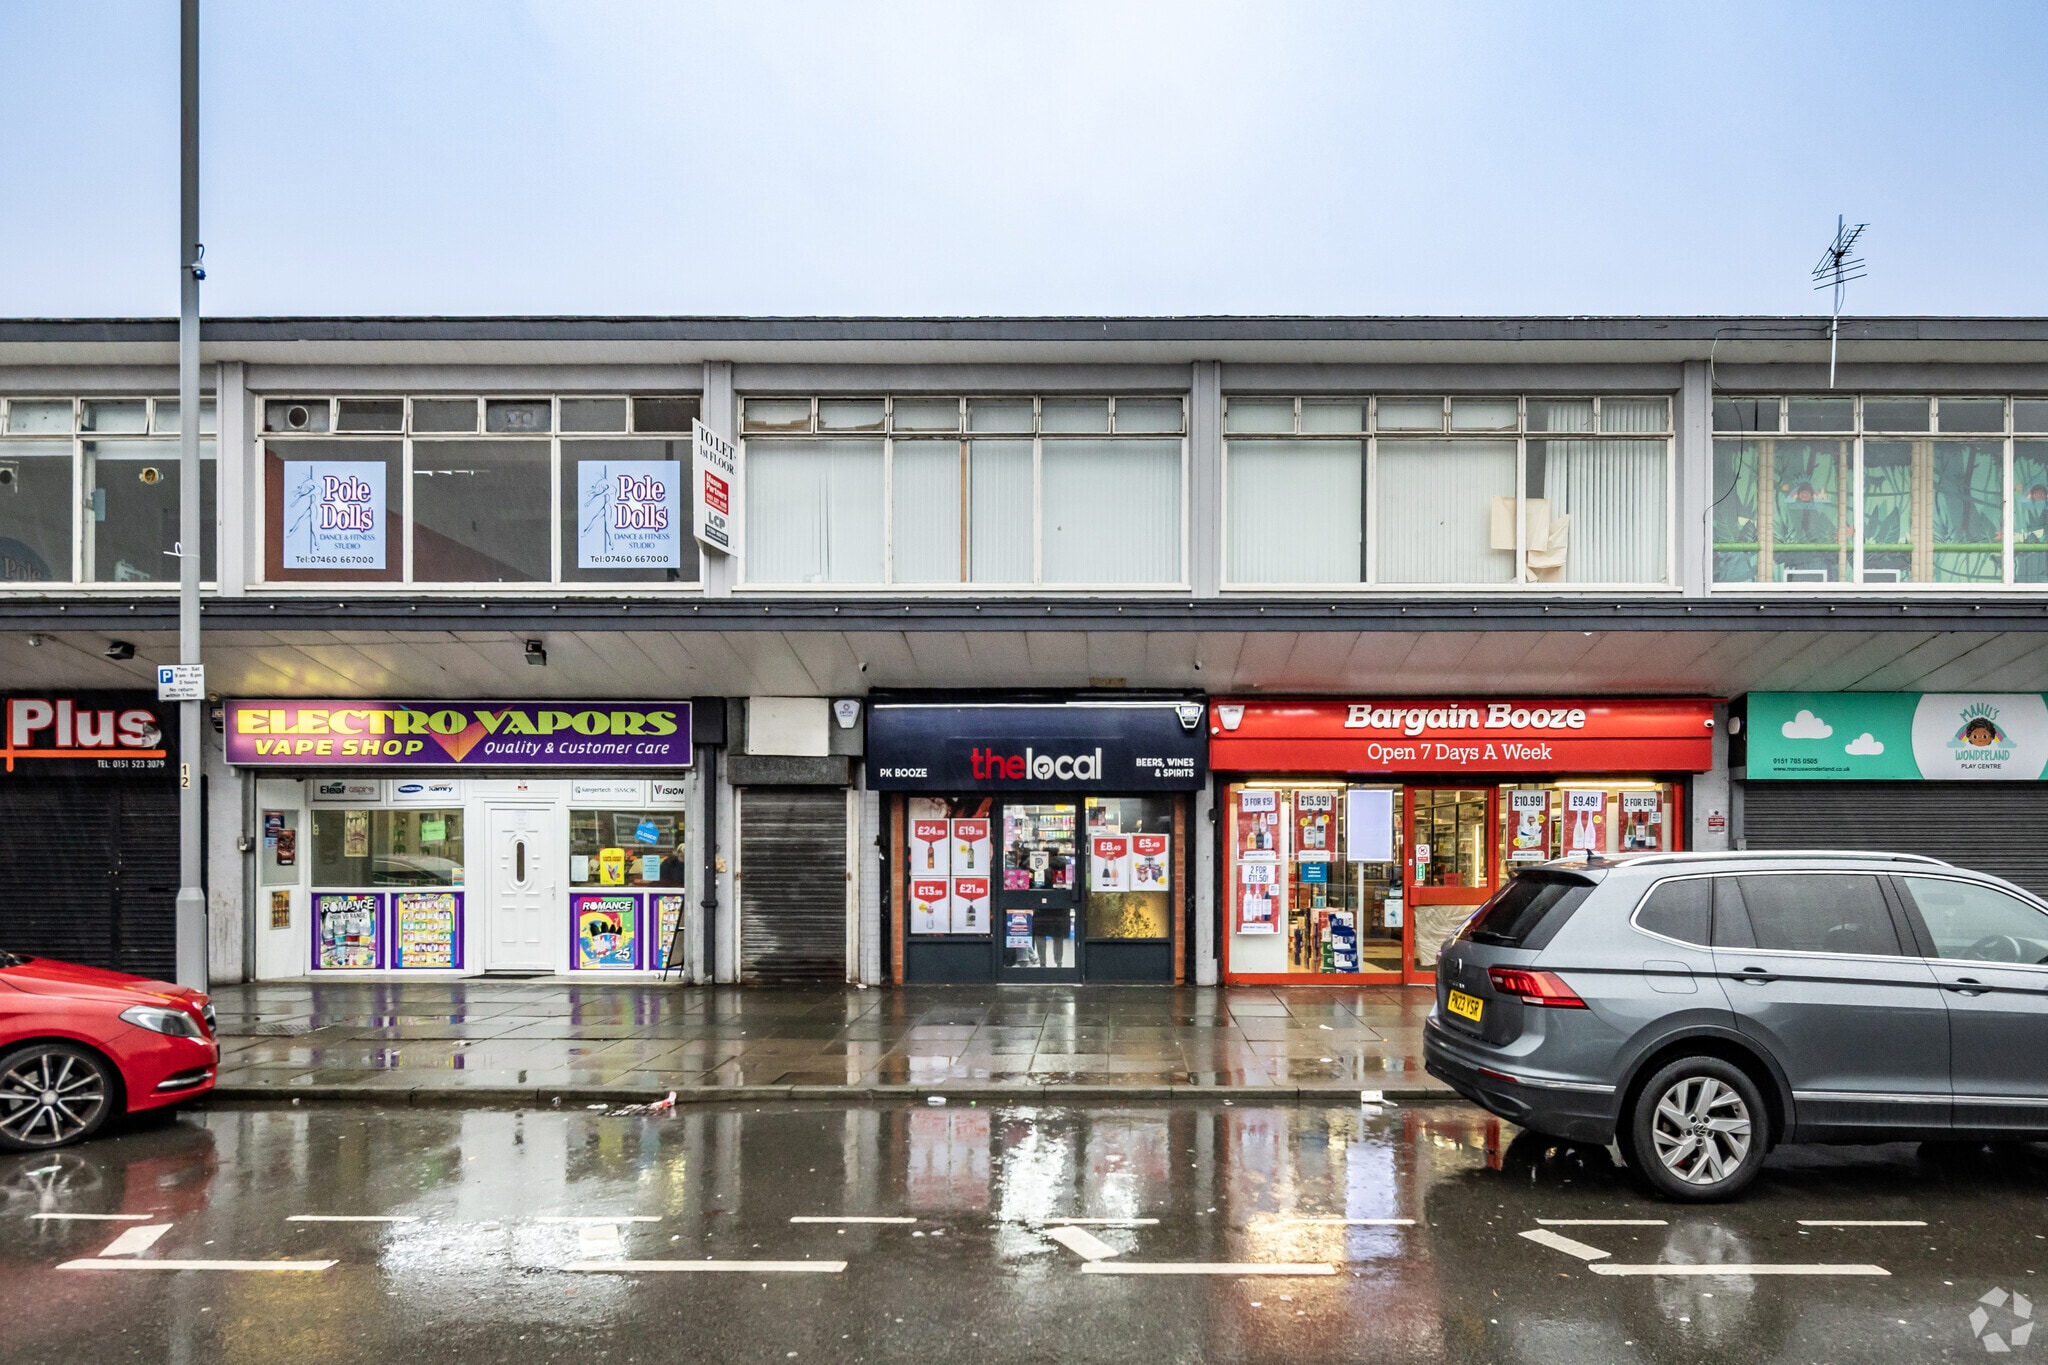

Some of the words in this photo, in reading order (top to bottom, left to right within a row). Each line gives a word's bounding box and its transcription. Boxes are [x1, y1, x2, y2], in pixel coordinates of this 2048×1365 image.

[698, 426, 713, 447] TO
[715, 437, 735, 460] LET
[699, 444, 708, 459] 1st
[709, 452, 735, 475] FLOOR
[323, 475, 372, 502] Pole
[617, 474, 666, 502] Pole
[320, 503, 374, 533] Dolls
[614, 503, 669, 532] Dolls
[708, 511, 726, 530] LCP
[295, 556, 338, 564] Tel:07460
[340, 556, 374, 564] 667000
[590, 555, 632, 563] Tel:07460
[634, 555, 669, 563] 667000
[1959, 702, 2000, 723] MANU'S
[11, 698, 162, 748] Plus
[237, 709, 468, 735] ELECTRO
[473, 710, 678, 736] VAPORS
[1344, 703, 1480, 737] Bargain
[1484, 703, 1587, 729] Booze
[254, 738, 334, 756] VAPE
[341, 738, 424, 756] SHOP
[484, 741, 542, 757] Quality
[544, 742, 555, 754] &
[558, 741, 633, 755] Customer
[635, 742, 670, 755] Care
[1367, 742, 1417, 764] Open
[1420, 742, 1432, 760] 7
[1435, 742, 1480, 765] Days
[1482, 742, 1498, 760] A
[1501, 742, 1553, 760] Week
[1955, 749, 2010, 761] WONDERLAND
[97, 759, 111, 768] TEL:
[112, 759, 129, 768] 0151
[131, 759, 145, 768] 523
[146, 759, 165, 768] 3079
[1135, 757, 1166, 769] BEERS,
[1166, 757, 1195, 767] WINES
[1772, 757, 1788, 765] 0151
[182, 764, 188, 776] 1
[879, 768, 893, 778] PK
[894, 768, 928, 778] BOOZE
[1154, 768, 1162, 778] &
[1162, 768, 1195, 778] SPIRITS
[181, 777, 189, 788] 2
[320, 783, 346, 795] Eleaf
[1244, 797, 1249, 807] 3
[1249, 797, 1262, 806] FOR
[1300, 795, 1330, 807] £15.99!
[1514, 795, 1544, 807] £10.99!
[1572, 795, 1599, 807] £9.49!
[1624, 798, 1629, 807] 2
[1630, 798, 1642, 807] FOR
[1643, 798, 1656, 807] £15!
[1100, 841, 1122, 852] £8.49
[1138, 838, 1160, 849] £5.49
[1250, 866, 1254, 874] 2
[1255, 866, 1267, 874] FOR
[321, 899, 375, 913] ROMANCE
[582, 901, 633, 912] ROMANCE
[614, 948, 631, 960] 25
